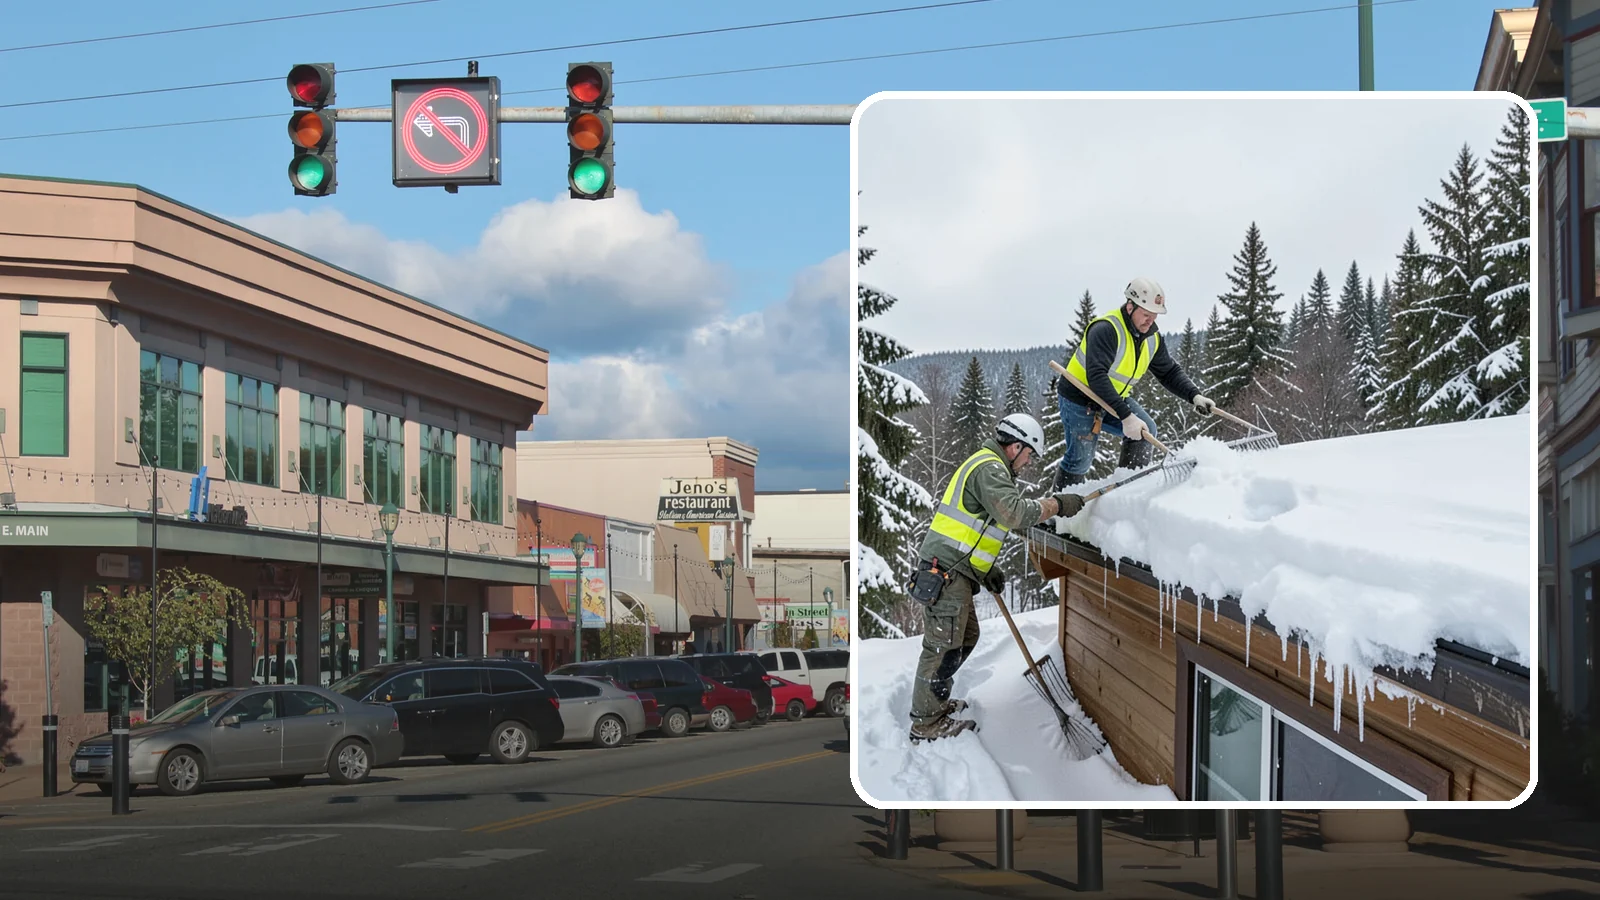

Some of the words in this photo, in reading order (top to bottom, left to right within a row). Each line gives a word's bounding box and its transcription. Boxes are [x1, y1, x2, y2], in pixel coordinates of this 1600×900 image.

[670, 480, 727, 494] Jeno's
[665, 496, 731, 509] restaurant
[659, 509, 681, 519] Italian
[685, 509, 715, 519] American
[715, 509, 737, 519] Cuisine
[2, 525, 13, 536] E.
[15, 525, 49, 536] MAIN
[785, 608, 795, 617] in
[797, 607, 828, 617] Street
[790, 619, 824, 627] lass
